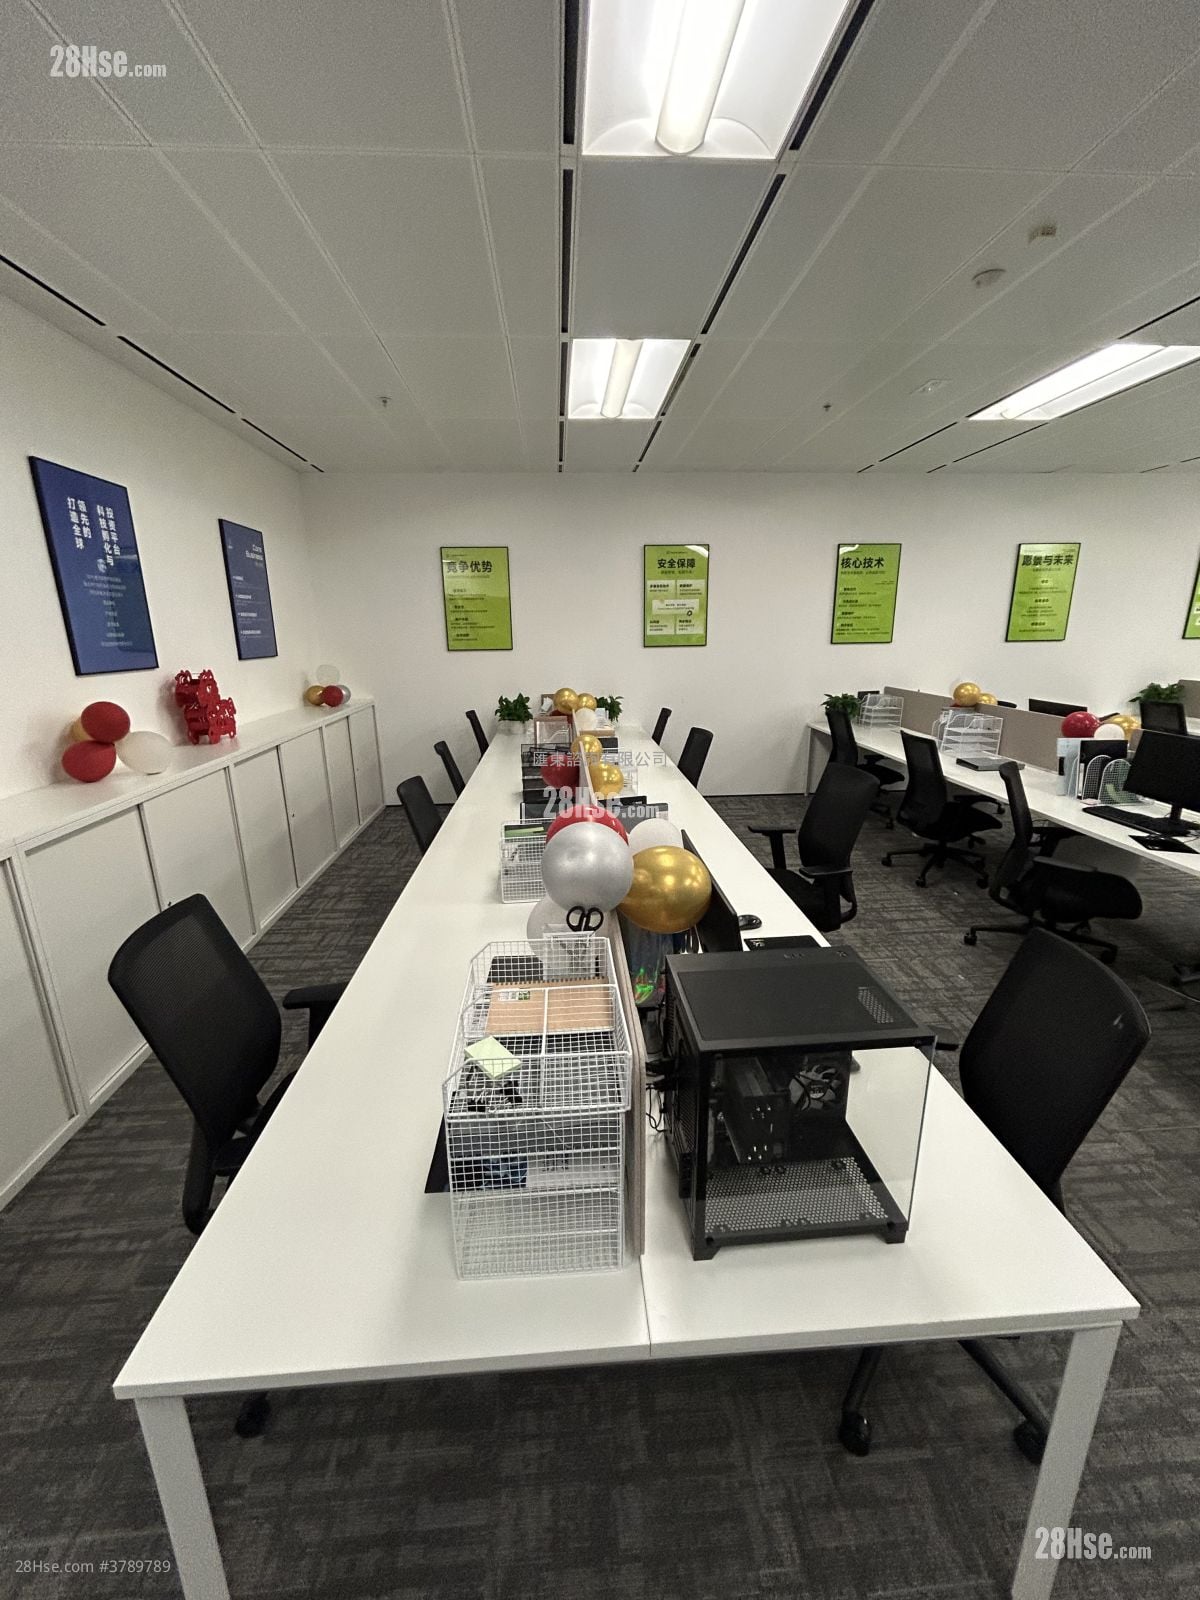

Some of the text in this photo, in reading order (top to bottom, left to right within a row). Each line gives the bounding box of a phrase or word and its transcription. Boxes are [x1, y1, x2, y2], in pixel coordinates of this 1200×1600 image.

[67, 496, 84, 550] 打造全球
[446, 560, 493, 573] 竞争优势
[657, 558, 696, 569] 安全保障
[840, 557, 885, 569] 核心技术
[1021, 554, 1075, 567] 愿景与未来
